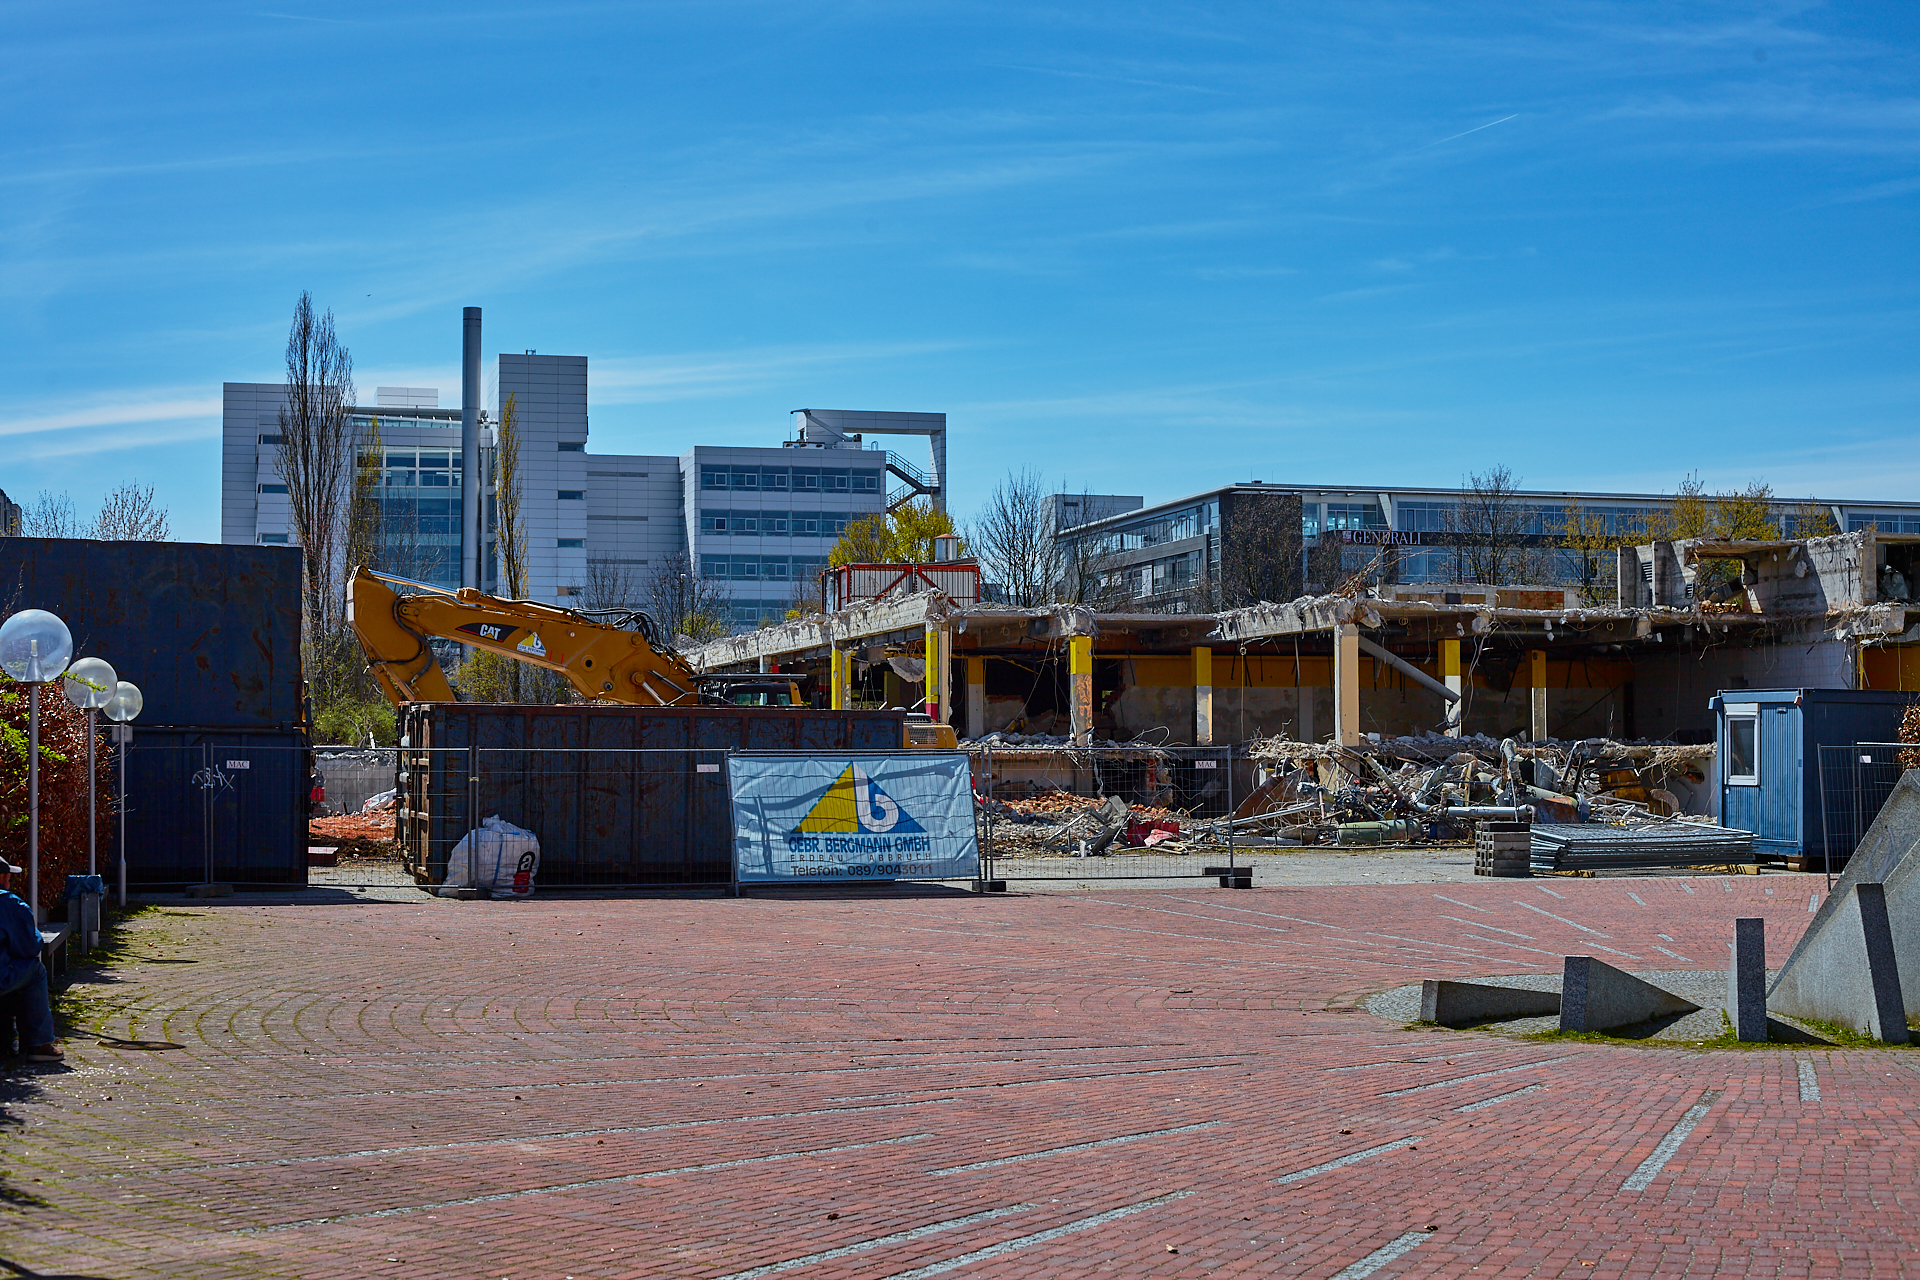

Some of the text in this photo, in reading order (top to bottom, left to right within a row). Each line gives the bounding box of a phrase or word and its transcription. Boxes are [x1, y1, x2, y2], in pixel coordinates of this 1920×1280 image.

[1353, 531, 1421, 545] GENERALI
[480, 624, 501, 640] CAT
[789, 836, 930, 853] GEBR. BERGMANN GMBH
[790, 853, 931, 862] ERDBAU ABBRUCH
[791, 863, 932, 876] Telefon: 089/9043011
